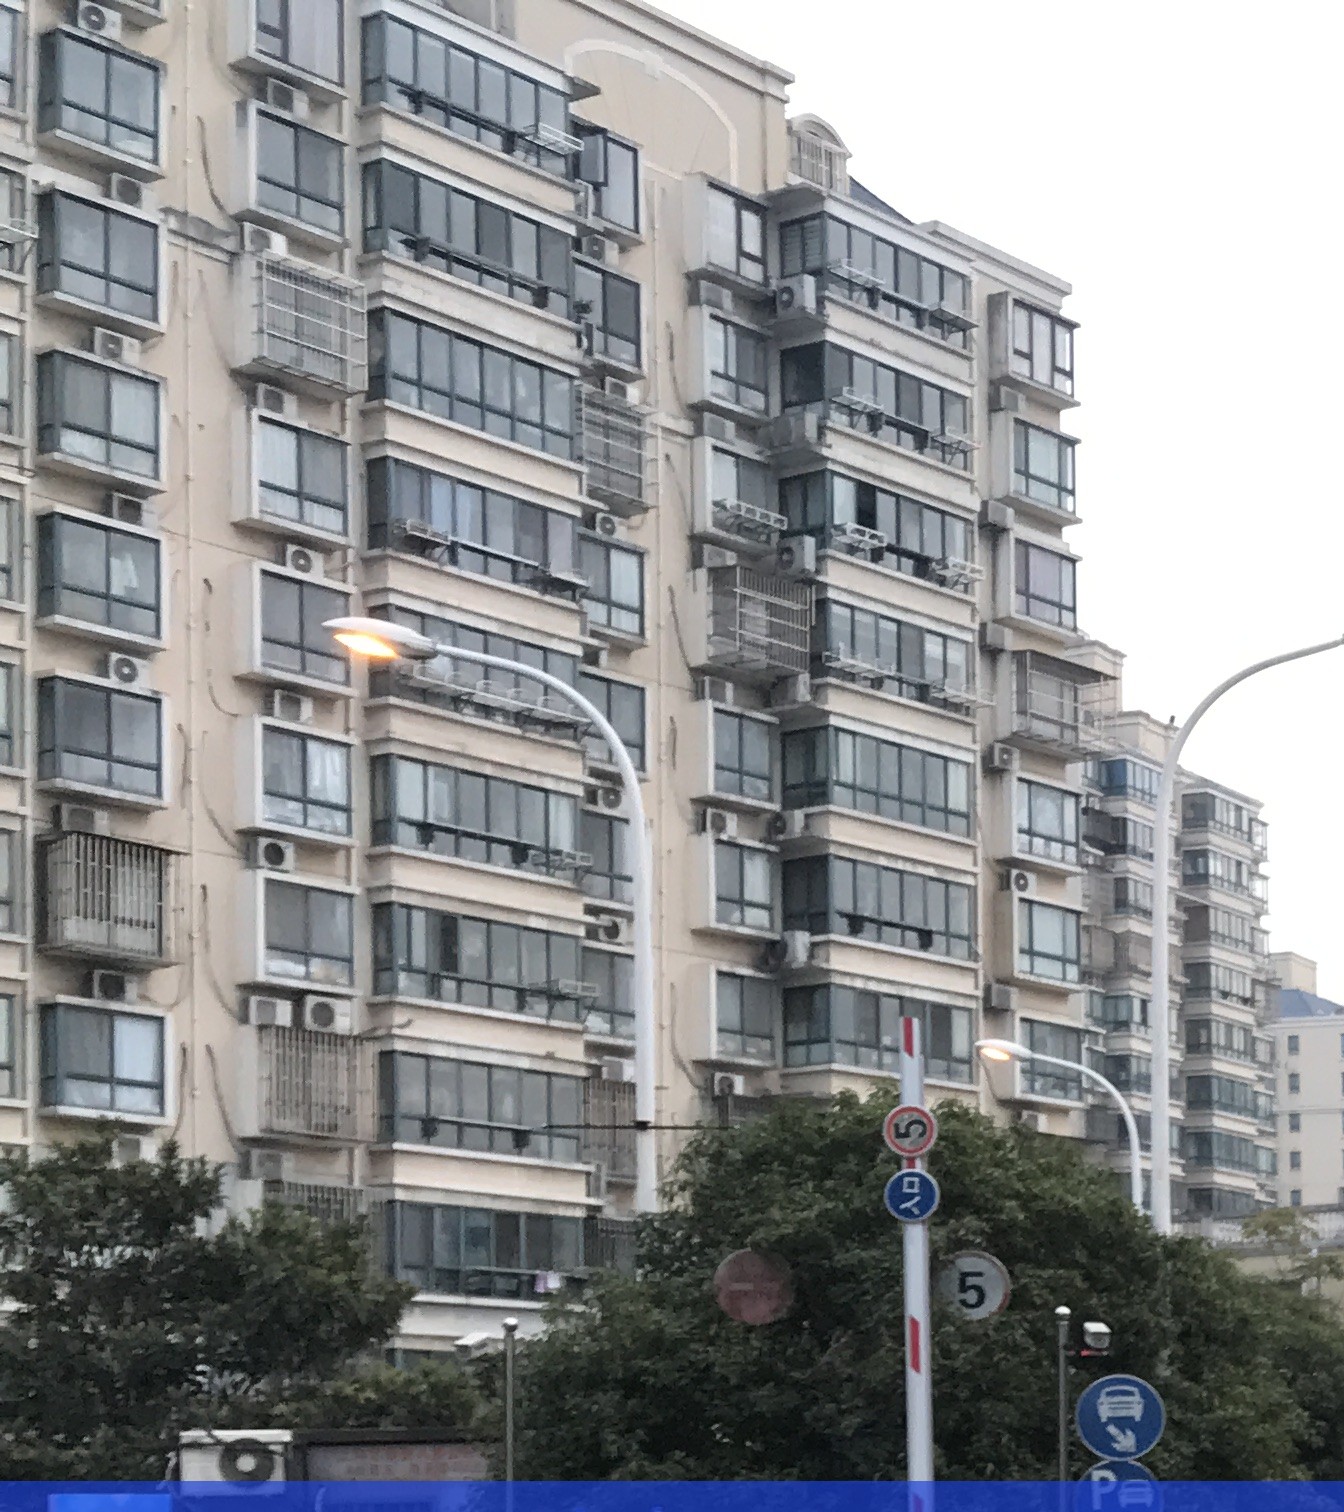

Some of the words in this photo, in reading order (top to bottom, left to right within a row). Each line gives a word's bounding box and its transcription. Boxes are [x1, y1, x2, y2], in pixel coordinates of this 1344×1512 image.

[893, 1119, 927, 1139] 5
[900, 1177, 920, 1215] 入口
[958, 1271, 986, 1309] 5
[1091, 1469, 1117, 1510] P
